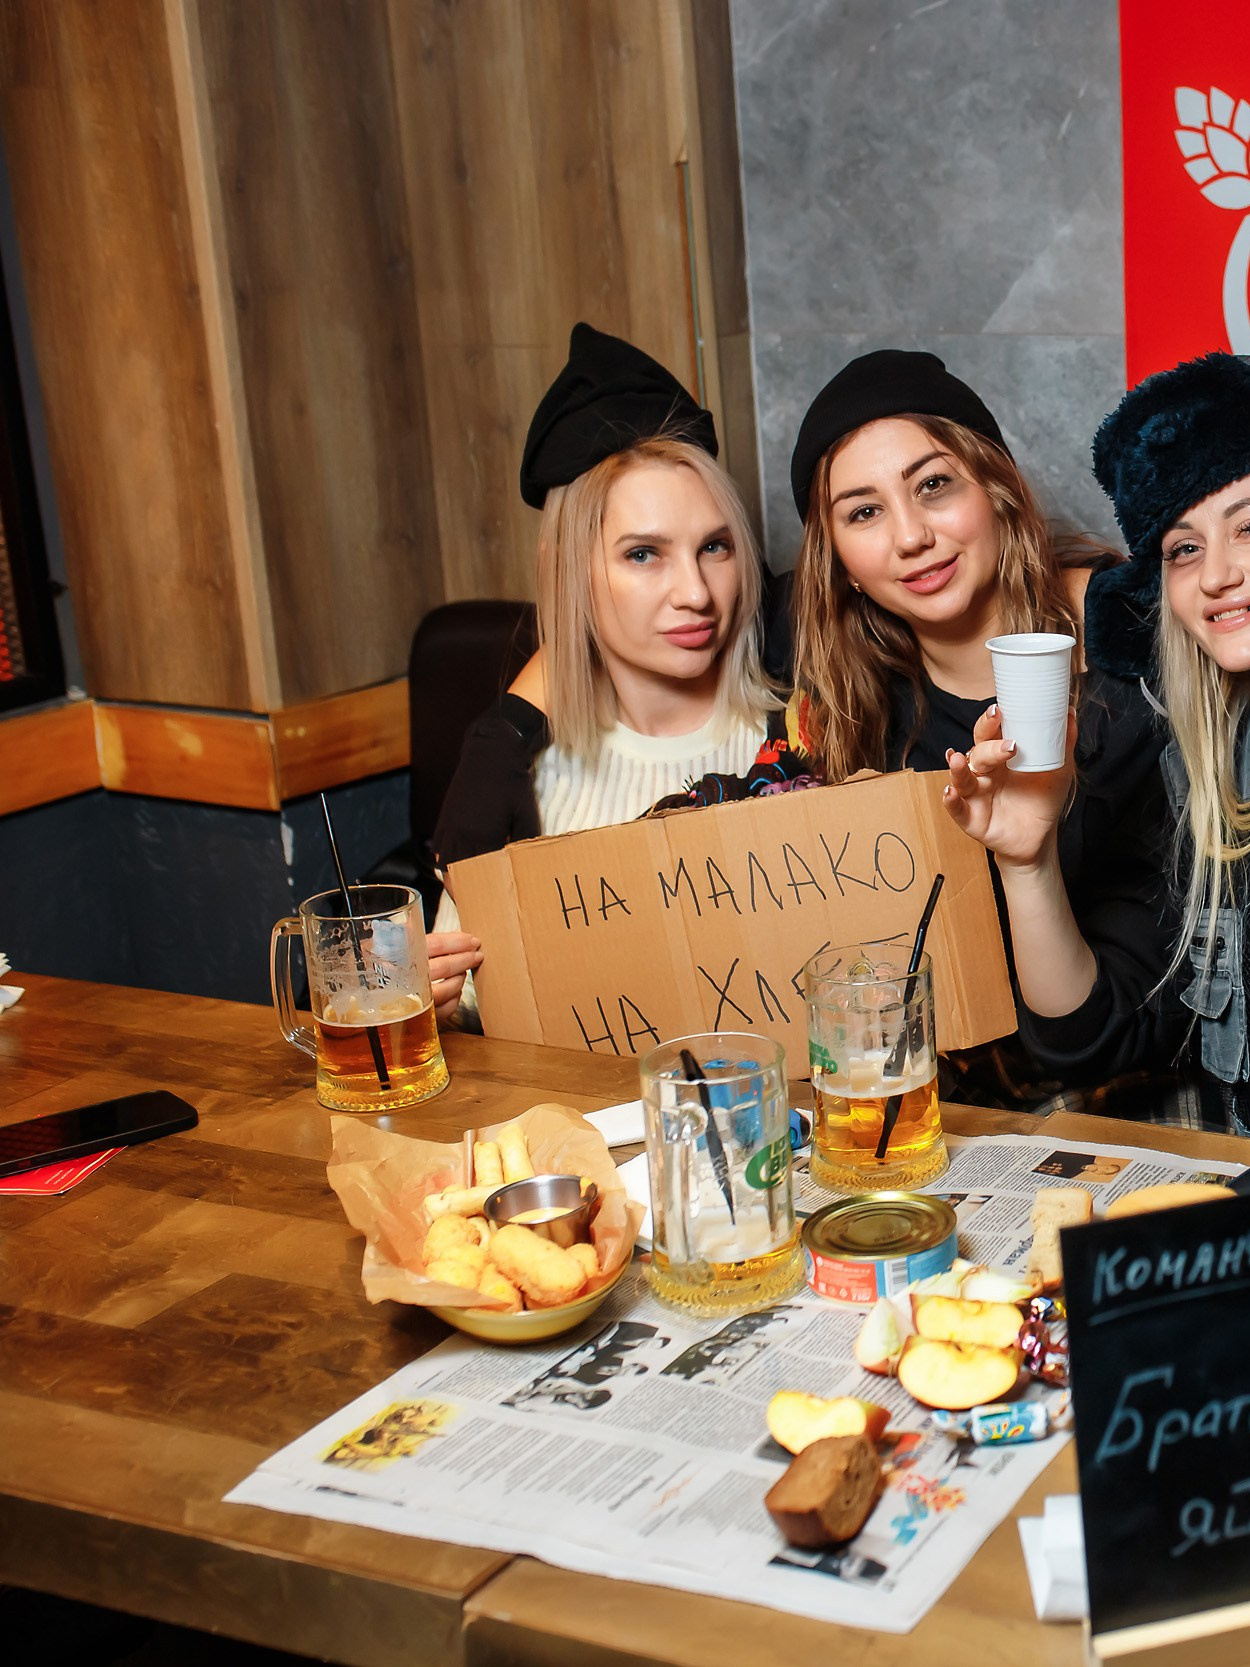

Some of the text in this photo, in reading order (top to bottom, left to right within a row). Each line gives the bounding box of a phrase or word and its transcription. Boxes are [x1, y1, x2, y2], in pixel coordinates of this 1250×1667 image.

[555, 831, 915, 930] НА МАЛАКО
[571, 932, 909, 1056] НА ХЛЕ
